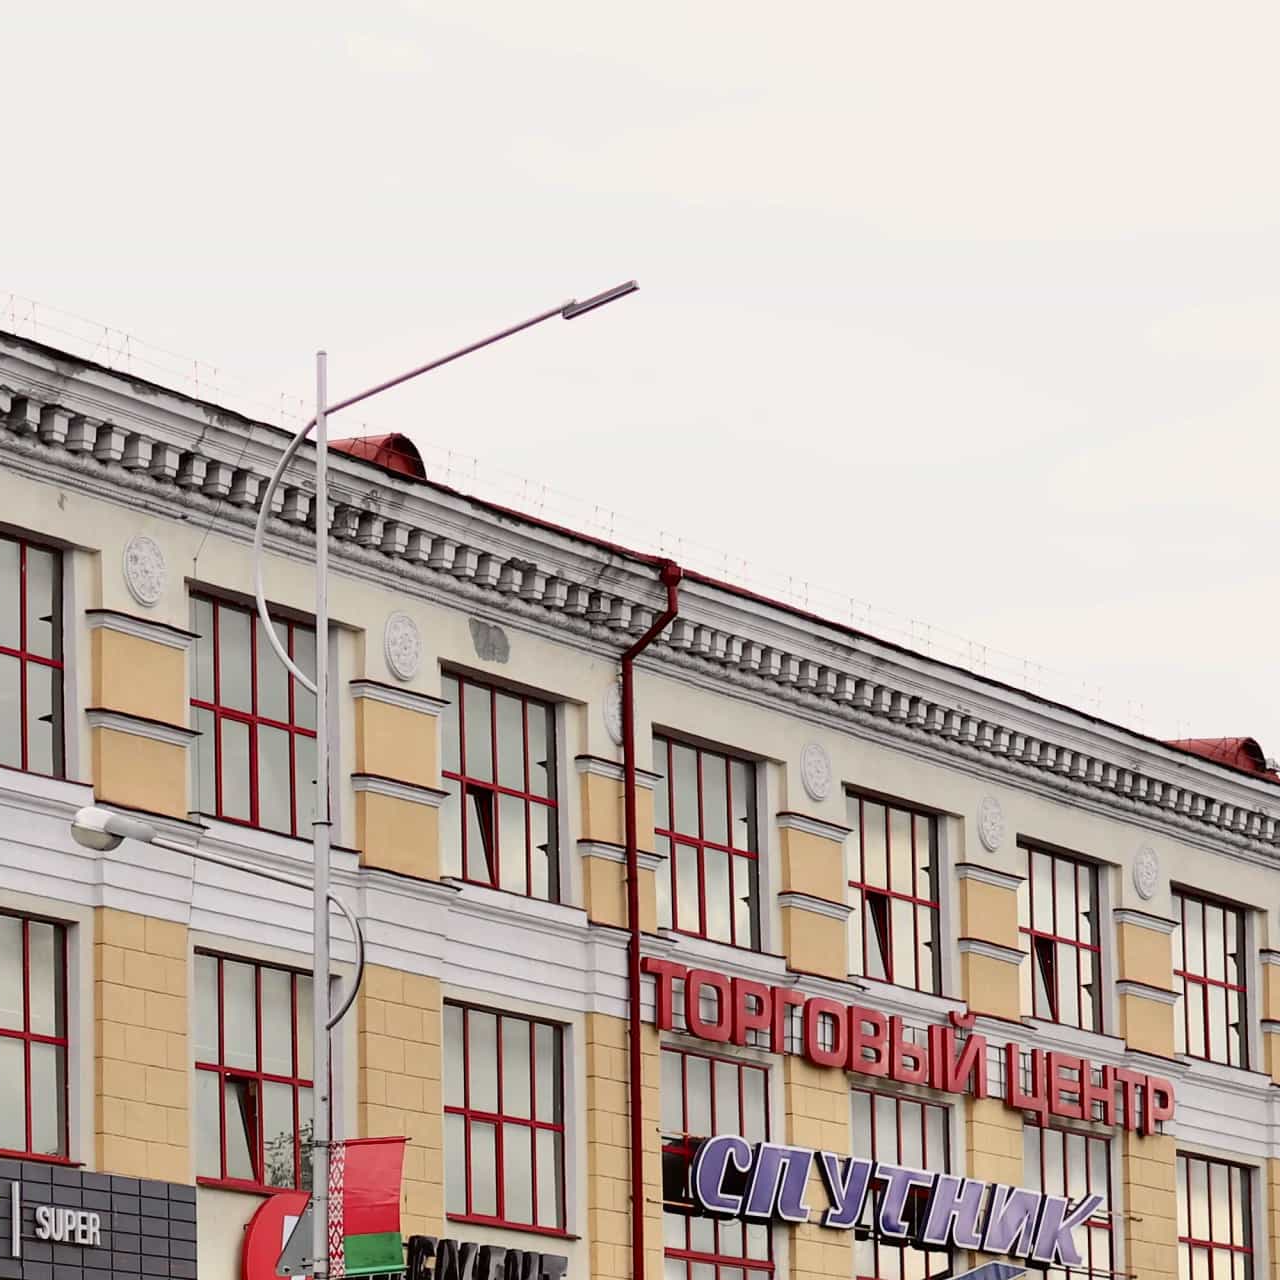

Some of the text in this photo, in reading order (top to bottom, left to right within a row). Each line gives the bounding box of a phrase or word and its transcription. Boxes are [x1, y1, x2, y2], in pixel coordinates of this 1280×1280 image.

[641, 957, 1176, 1136] ТОРГОВЫЙ ЦЕНТР
[35, 1206, 101, 1246] SUPER
[694, 1134, 1105, 1267] СПУТНИК
